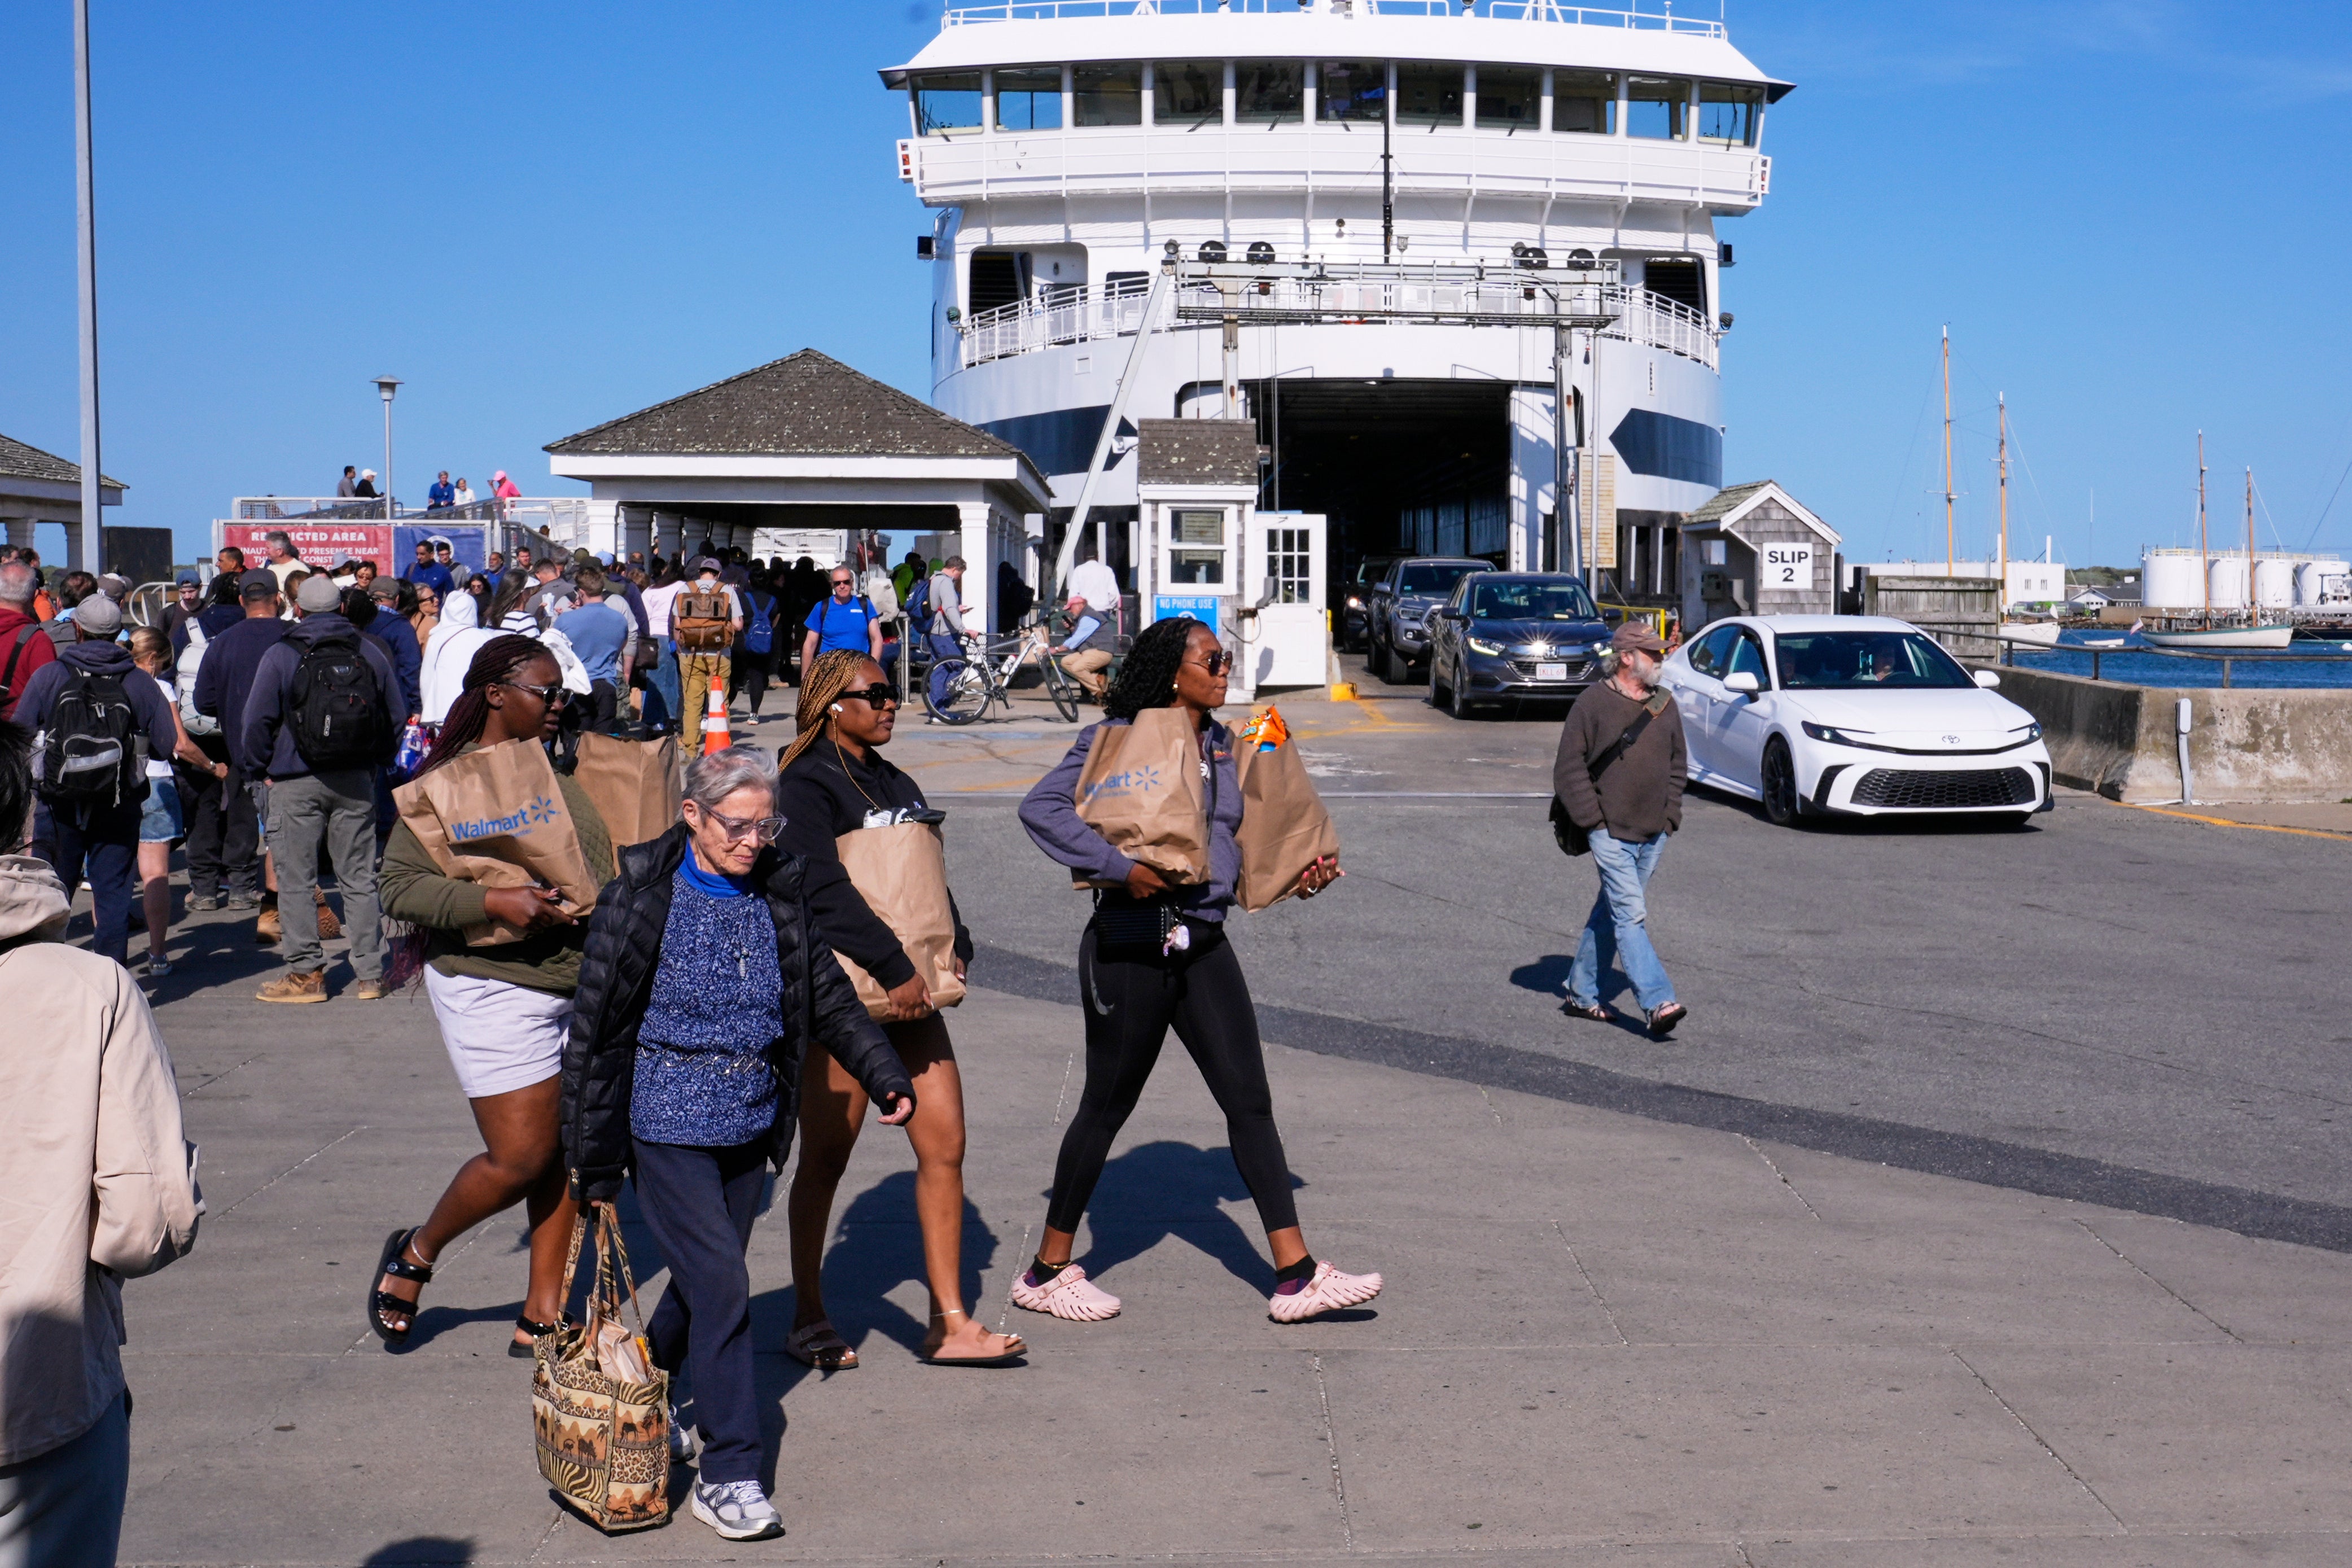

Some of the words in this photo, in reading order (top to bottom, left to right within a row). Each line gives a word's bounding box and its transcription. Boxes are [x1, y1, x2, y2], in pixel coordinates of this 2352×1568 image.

[251, 532, 329, 541] REICTED
[331, 532, 366, 541] AREA
[1768, 550, 1808, 564] SLIP
[1782, 567, 1794, 582] 2
[1160, 598, 1170, 608] NO
[1172, 598, 1196, 608] PHONE
[1198, 598, 1212, 608] USE
[452, 808, 530, 840] Walmart
